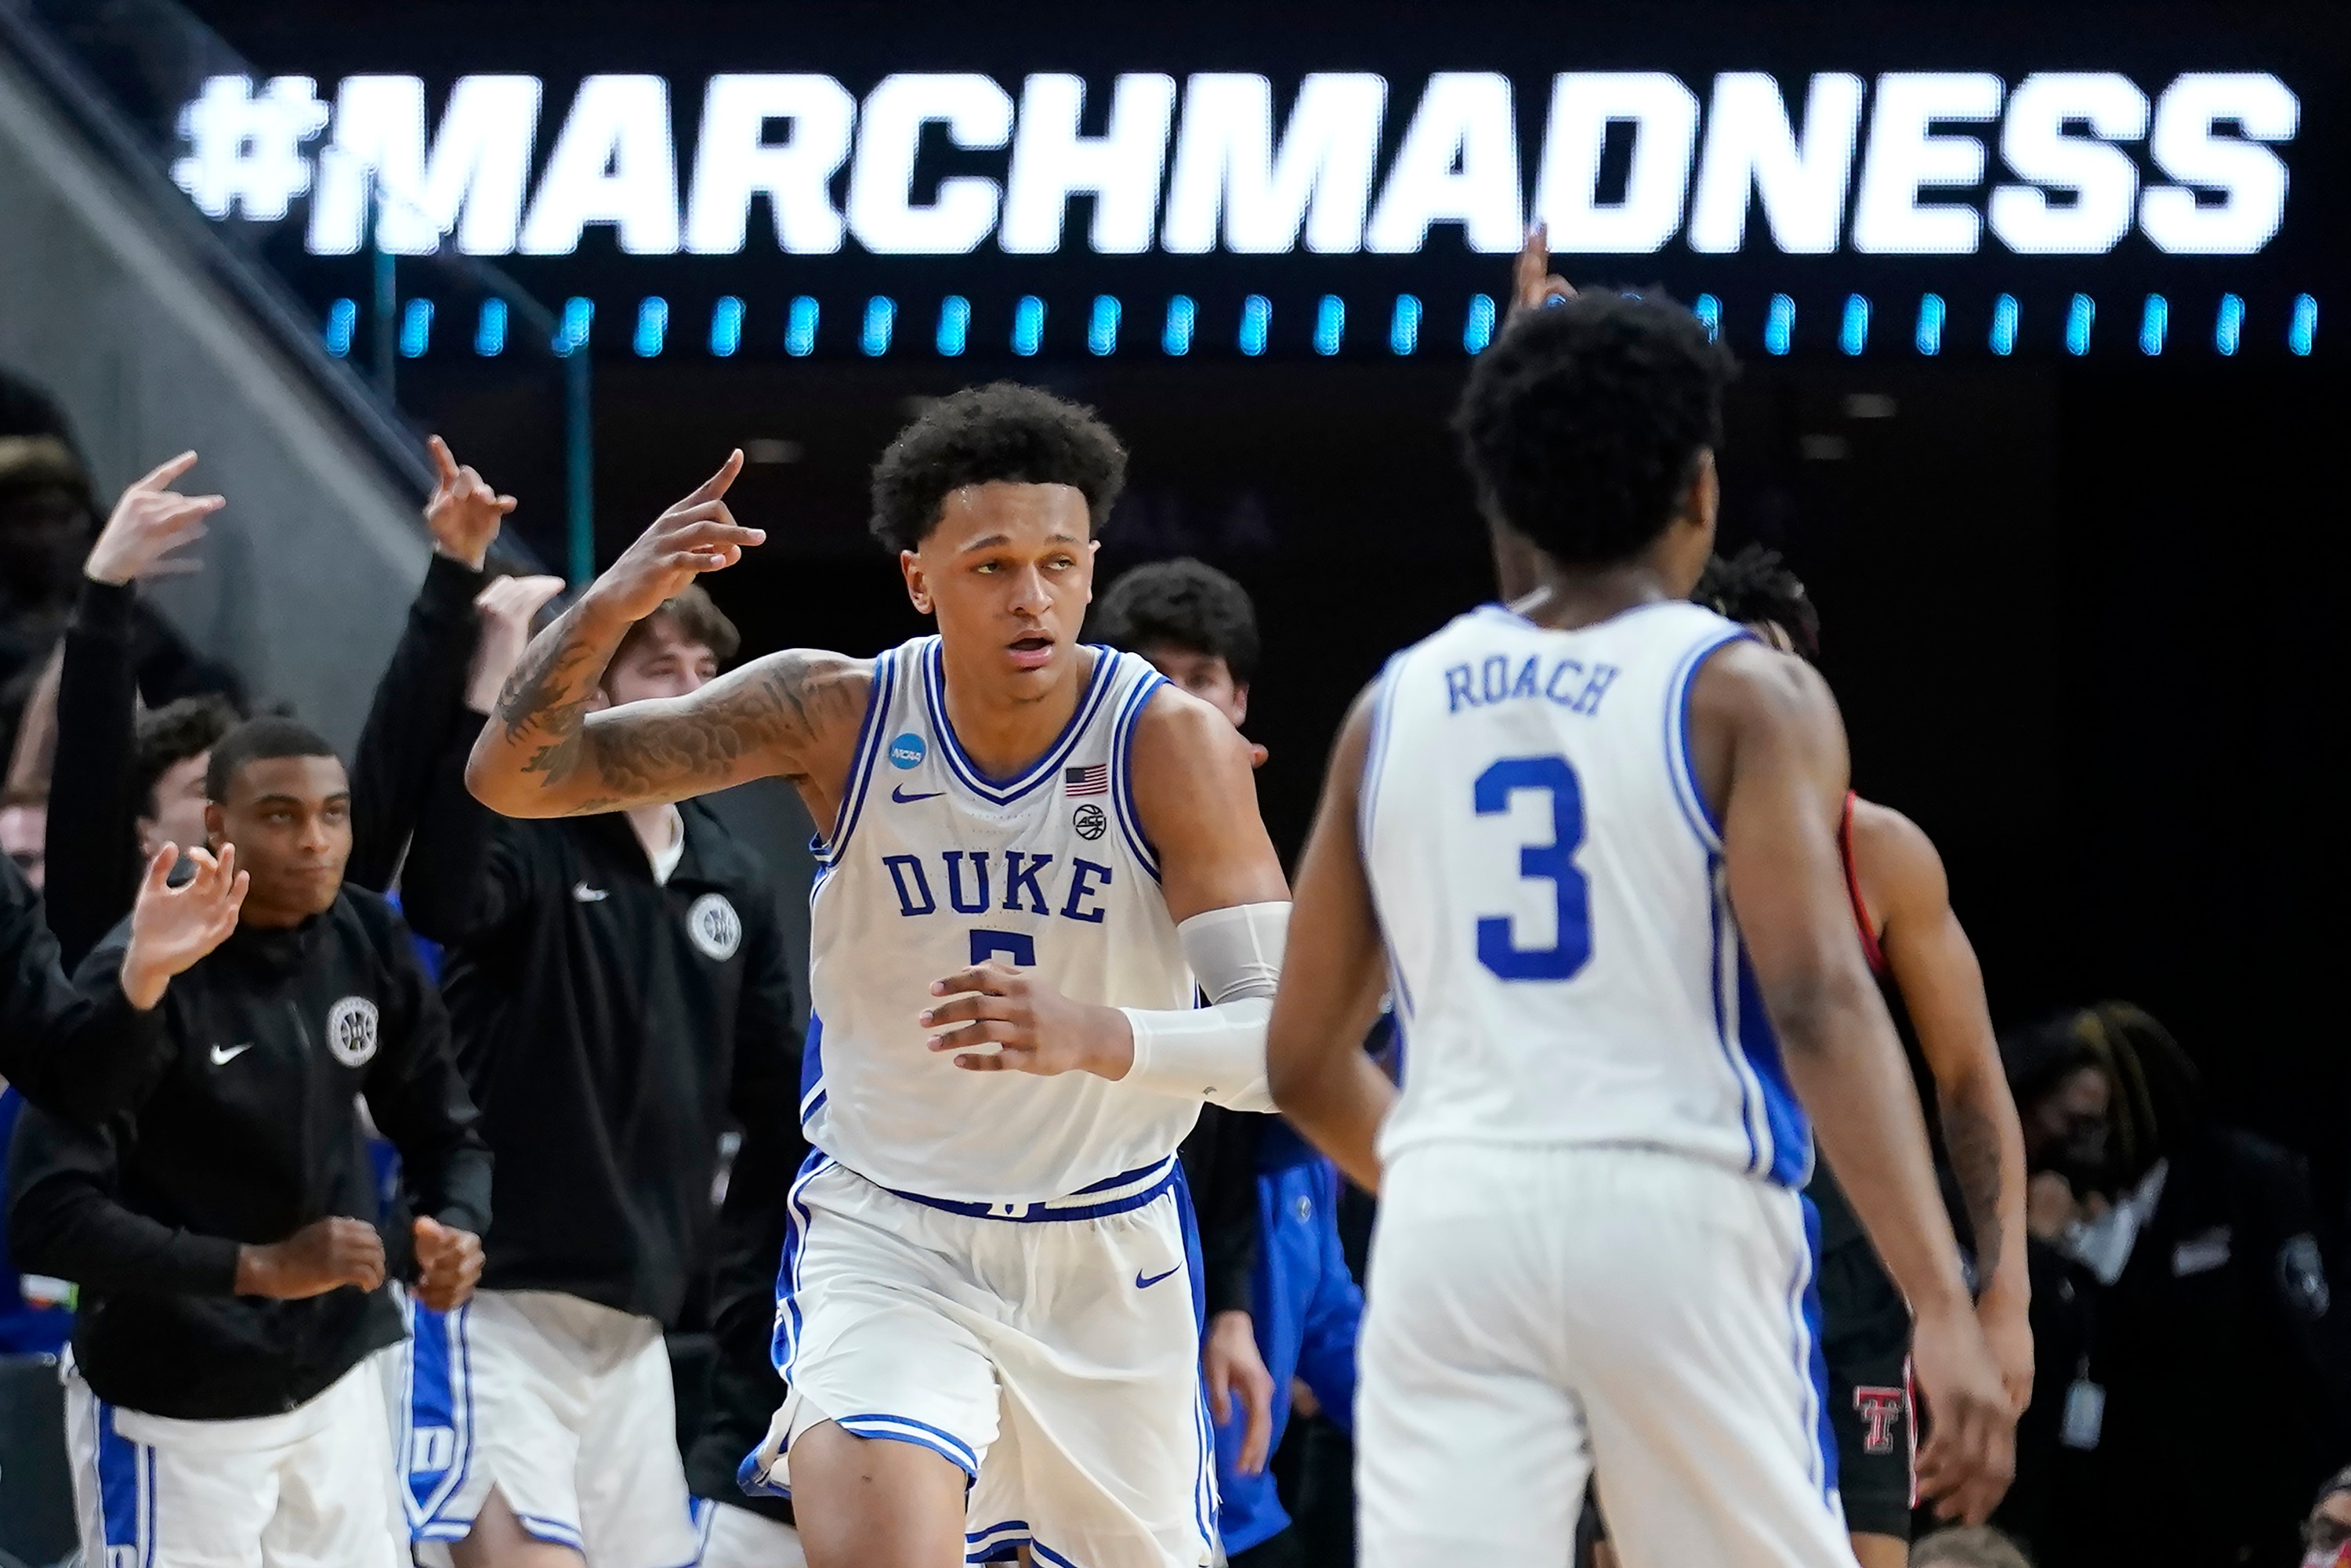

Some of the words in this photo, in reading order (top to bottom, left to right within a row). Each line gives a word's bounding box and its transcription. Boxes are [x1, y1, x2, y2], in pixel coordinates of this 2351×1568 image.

[169, 73, 2301, 255] #MARCHMADNESS
[1444, 654, 1621, 716] ROACH
[892, 748, 922, 761] NCAA
[1076, 815, 1103, 827] ACC
[882, 850, 1113, 924] DUKE
[1474, 755, 1594, 981] 3
